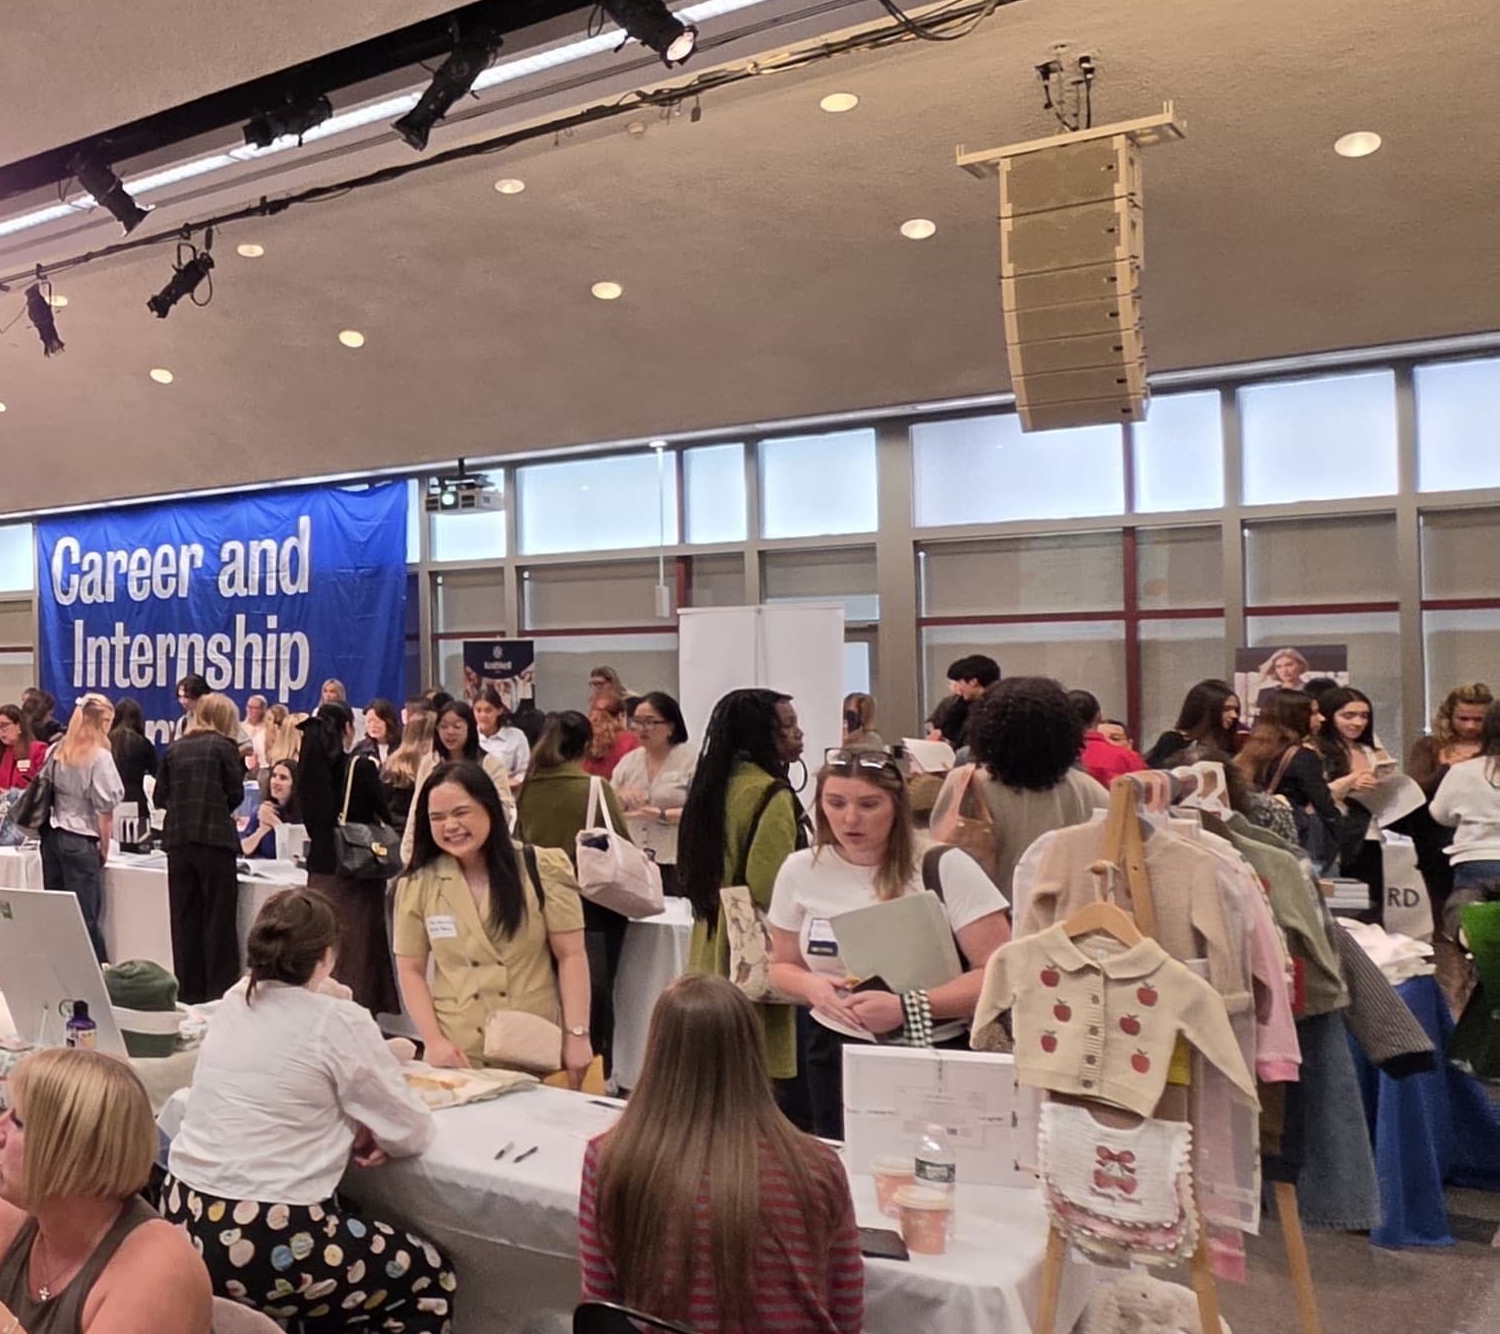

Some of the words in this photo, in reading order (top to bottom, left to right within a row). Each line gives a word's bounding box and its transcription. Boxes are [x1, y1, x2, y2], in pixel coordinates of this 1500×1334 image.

[51, 536, 204, 606] Career
[218, 515, 311, 599] and
[73, 613, 310, 704] Internship
